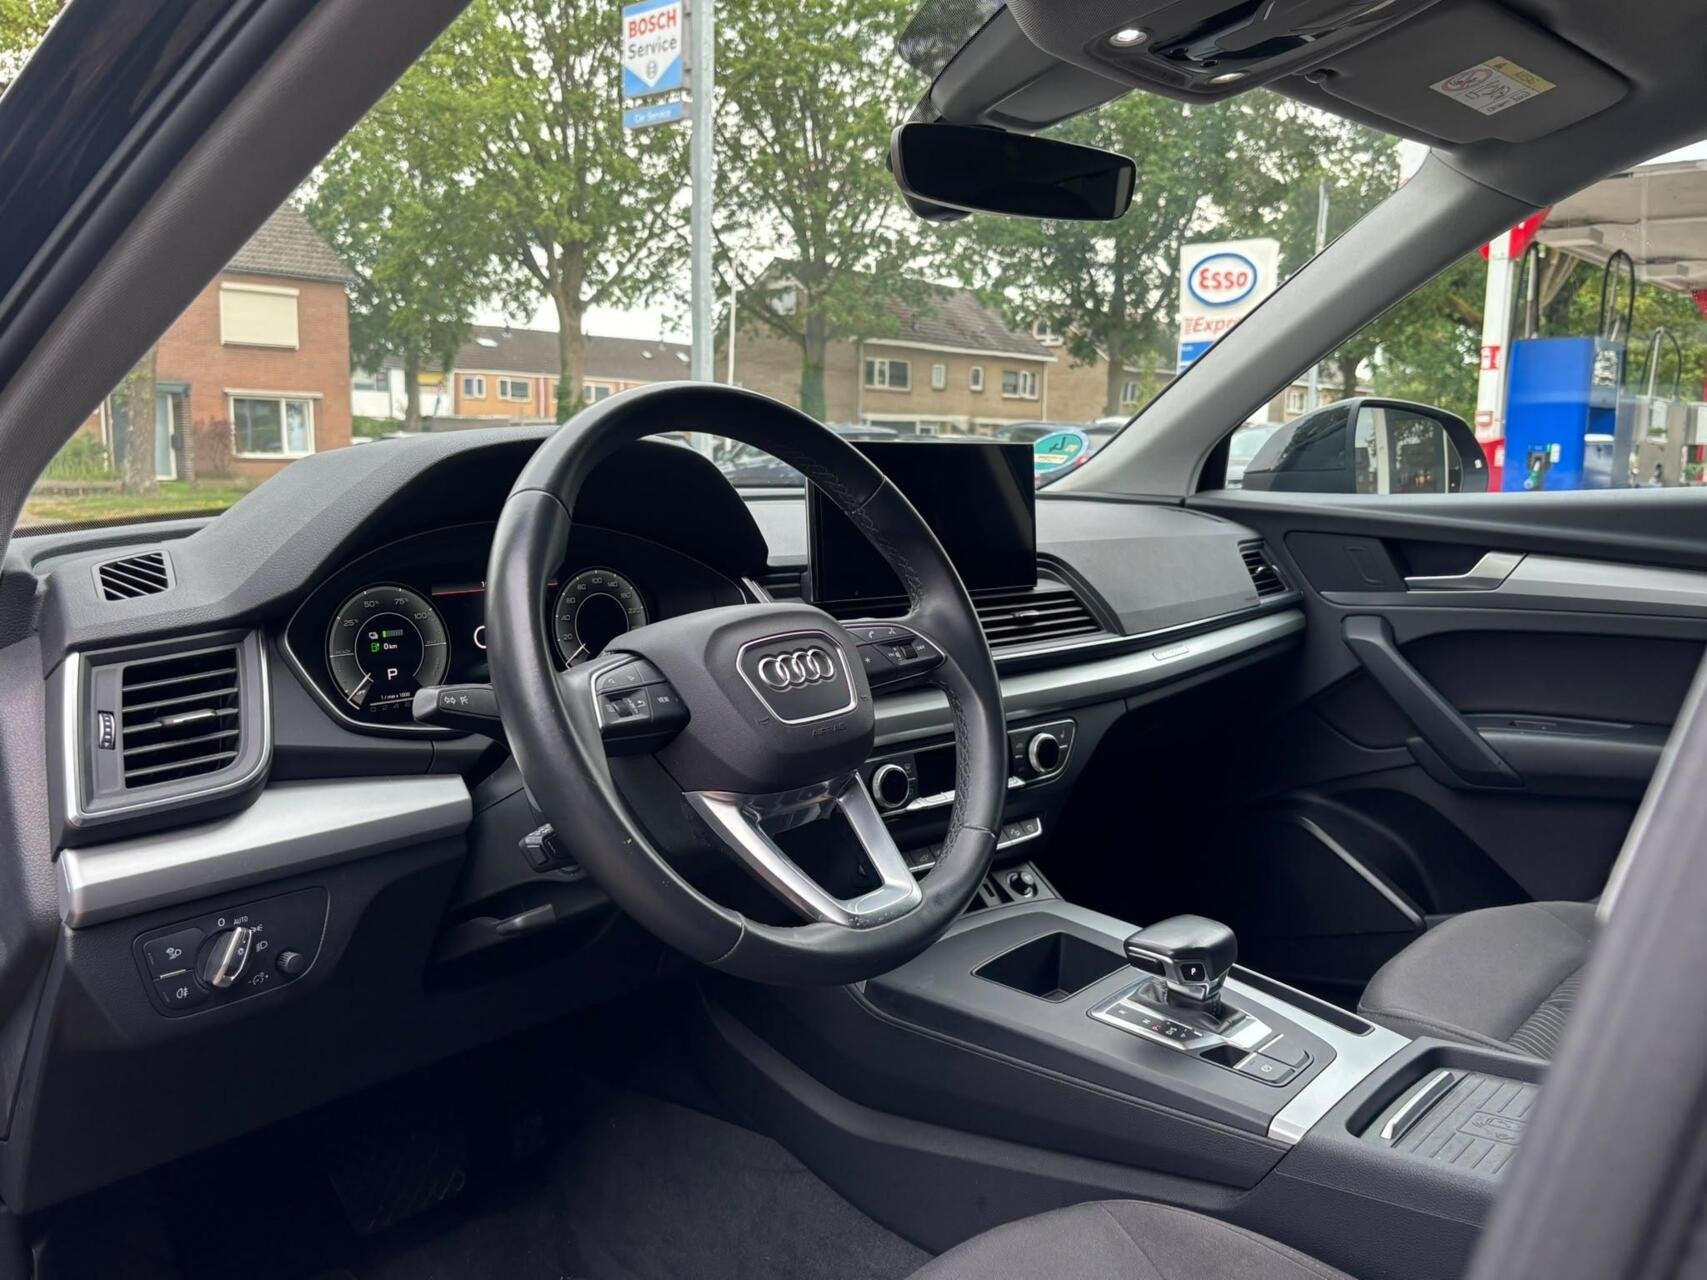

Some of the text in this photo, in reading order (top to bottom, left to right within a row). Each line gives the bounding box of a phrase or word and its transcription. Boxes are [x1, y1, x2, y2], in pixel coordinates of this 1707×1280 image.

[628, 9, 677, 38] BOSCH
[628, 37, 677, 59] Service
[1198, 268, 1248, 290] Esso
[387, 668, 398, 680] P
[233, 915, 248, 925] AUTO
